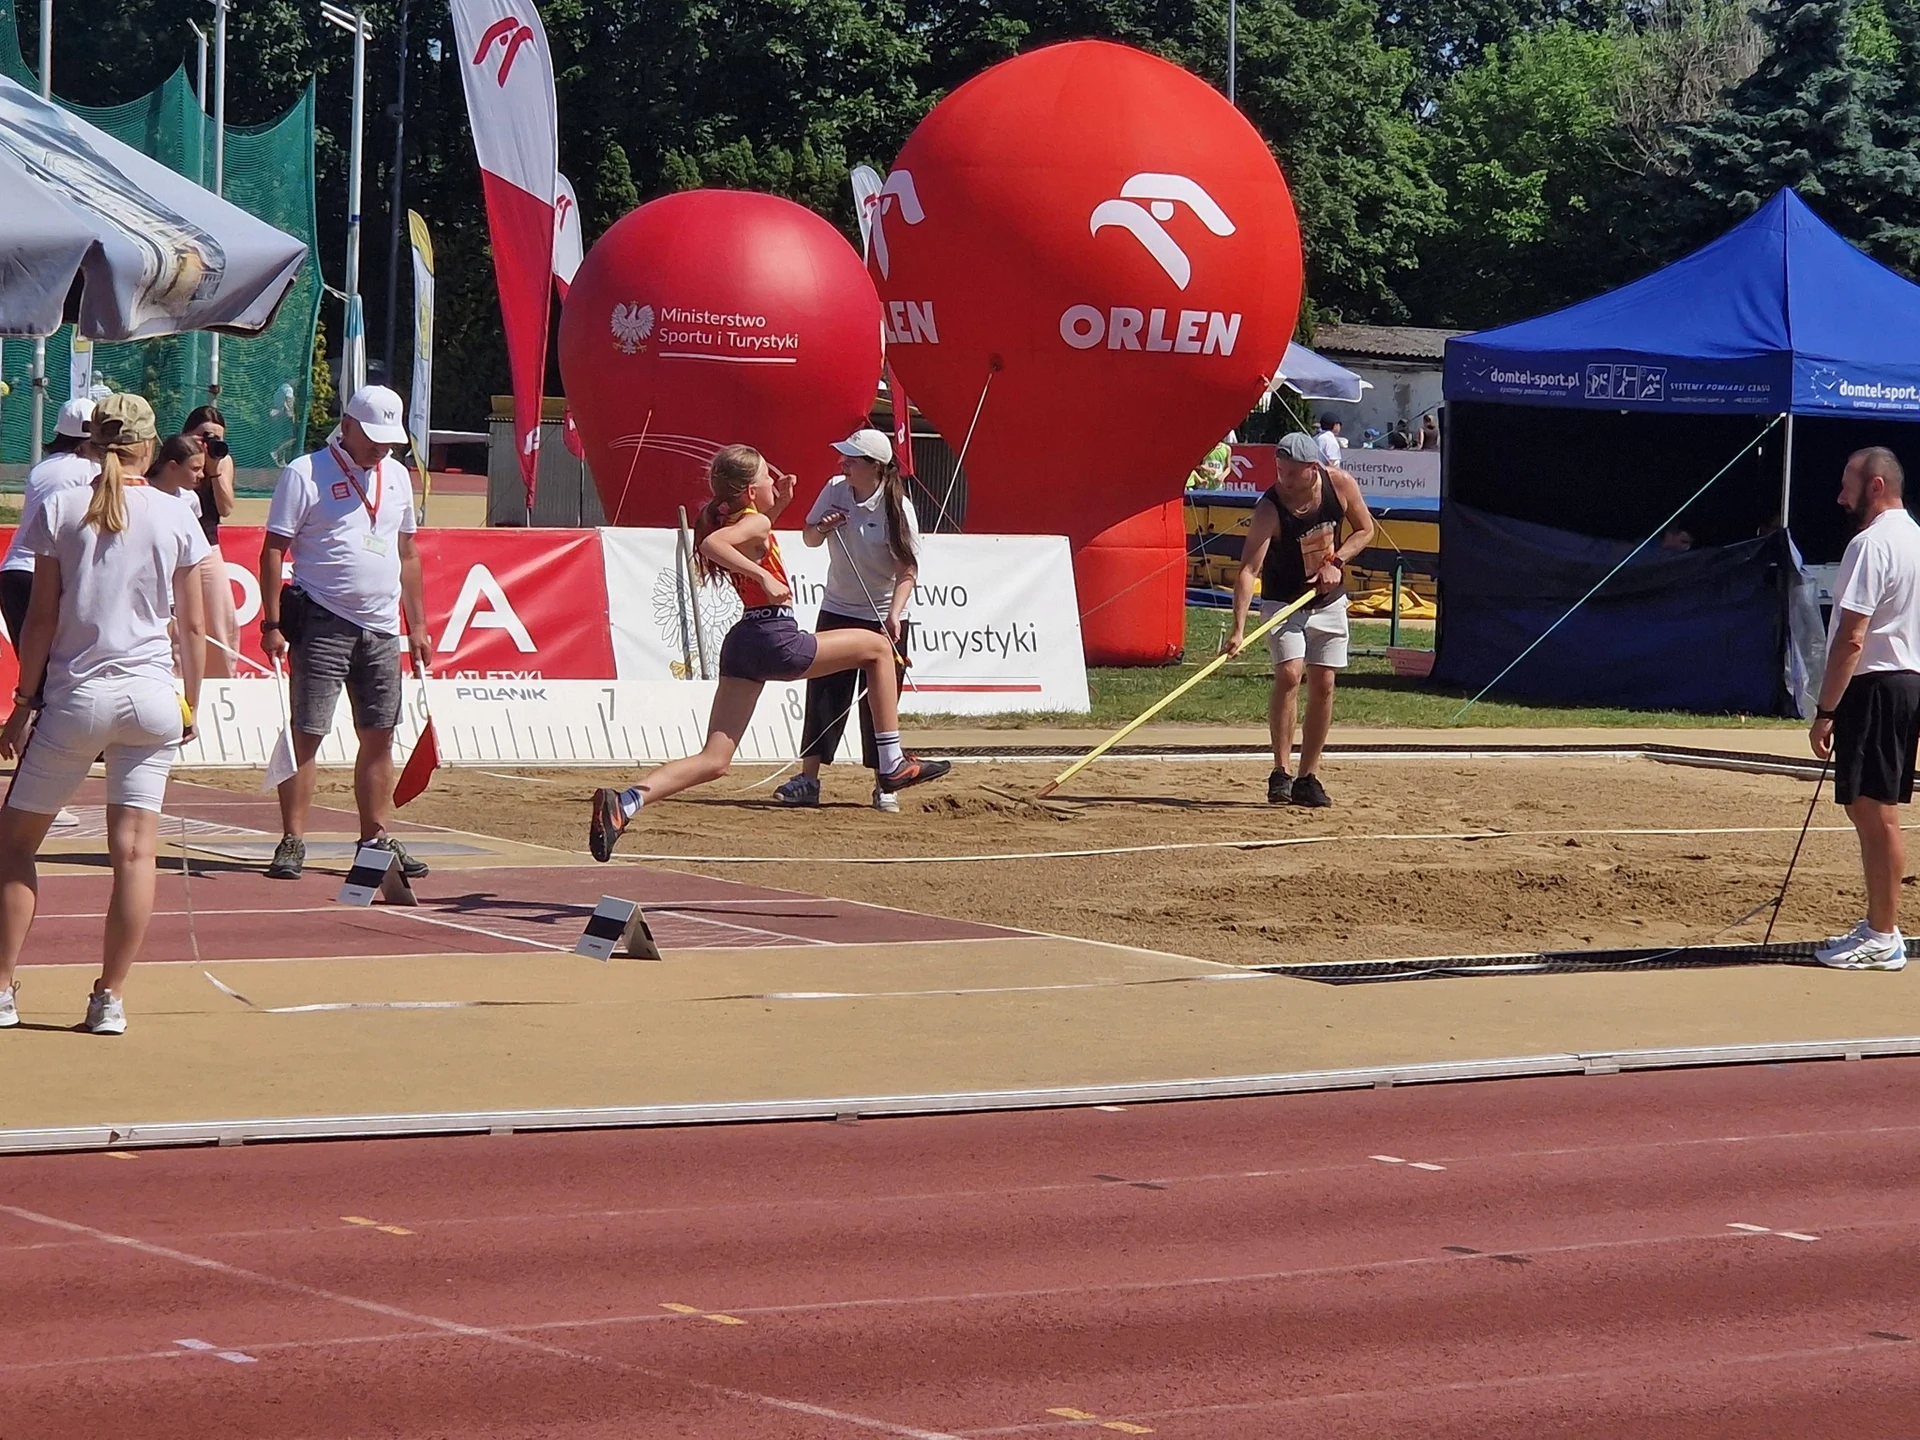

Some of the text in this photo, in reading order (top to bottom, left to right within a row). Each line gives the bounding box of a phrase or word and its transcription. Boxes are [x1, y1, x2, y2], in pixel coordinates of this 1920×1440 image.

[660, 307, 766, 328] Ministerstwo
[883, 301, 939, 343] LEN
[659, 328, 799, 351] Sportu i Turystyki
[1059, 303, 1242, 356] ORLEN
[1490, 368, 1580, 390] domtel-sport.pl
[1839, 380, 1920, 402] domtel-sport.
[383, 411, 396, 420] NY
[1223, 481, 1256, 492] RLEN
[1377, 476, 1426, 490] Turystyki
[908, 621, 1038, 659] Turystyki
[219, 687, 236, 721] 5
[416, 687, 431, 721] 6
[456, 687, 548, 701] POLANIK
[601, 688, 615, 721] 7
[785, 688, 804, 721] 8
